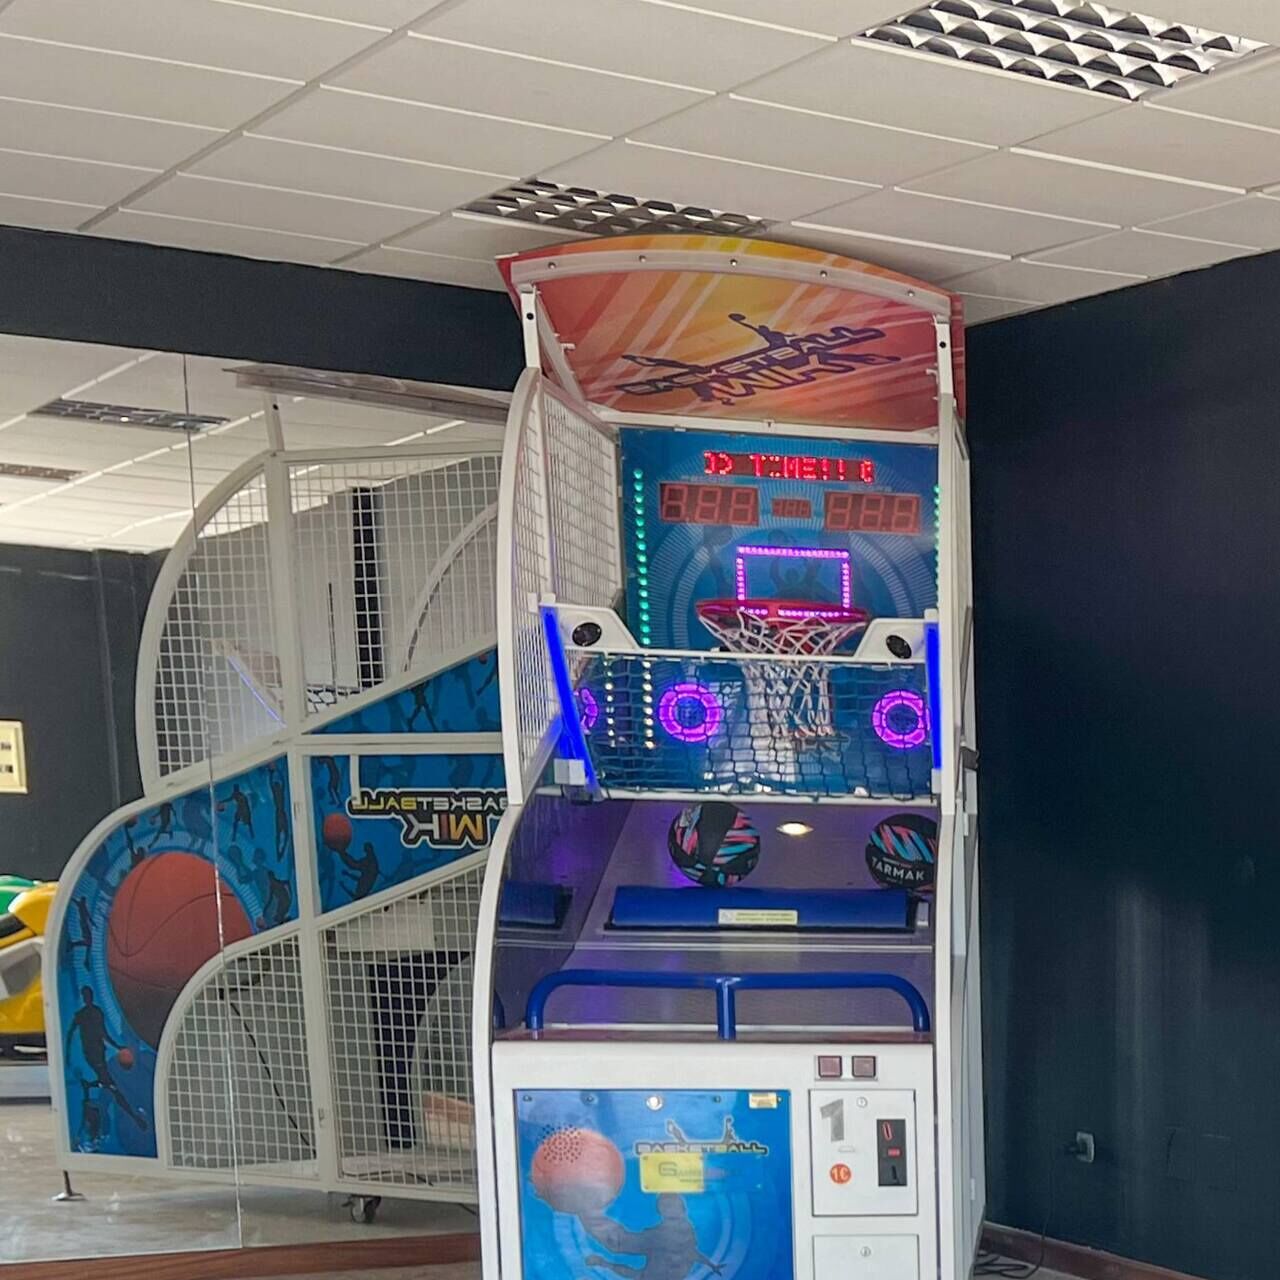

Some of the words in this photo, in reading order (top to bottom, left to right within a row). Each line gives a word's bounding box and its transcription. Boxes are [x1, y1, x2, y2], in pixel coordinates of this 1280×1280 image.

[616, 326, 886, 397] BASKETBALL
[871, 857, 925, 881] TARMAK
[820, 1099, 845, 1143] 1
[637, 1143, 768, 1154] BASKETBALL
